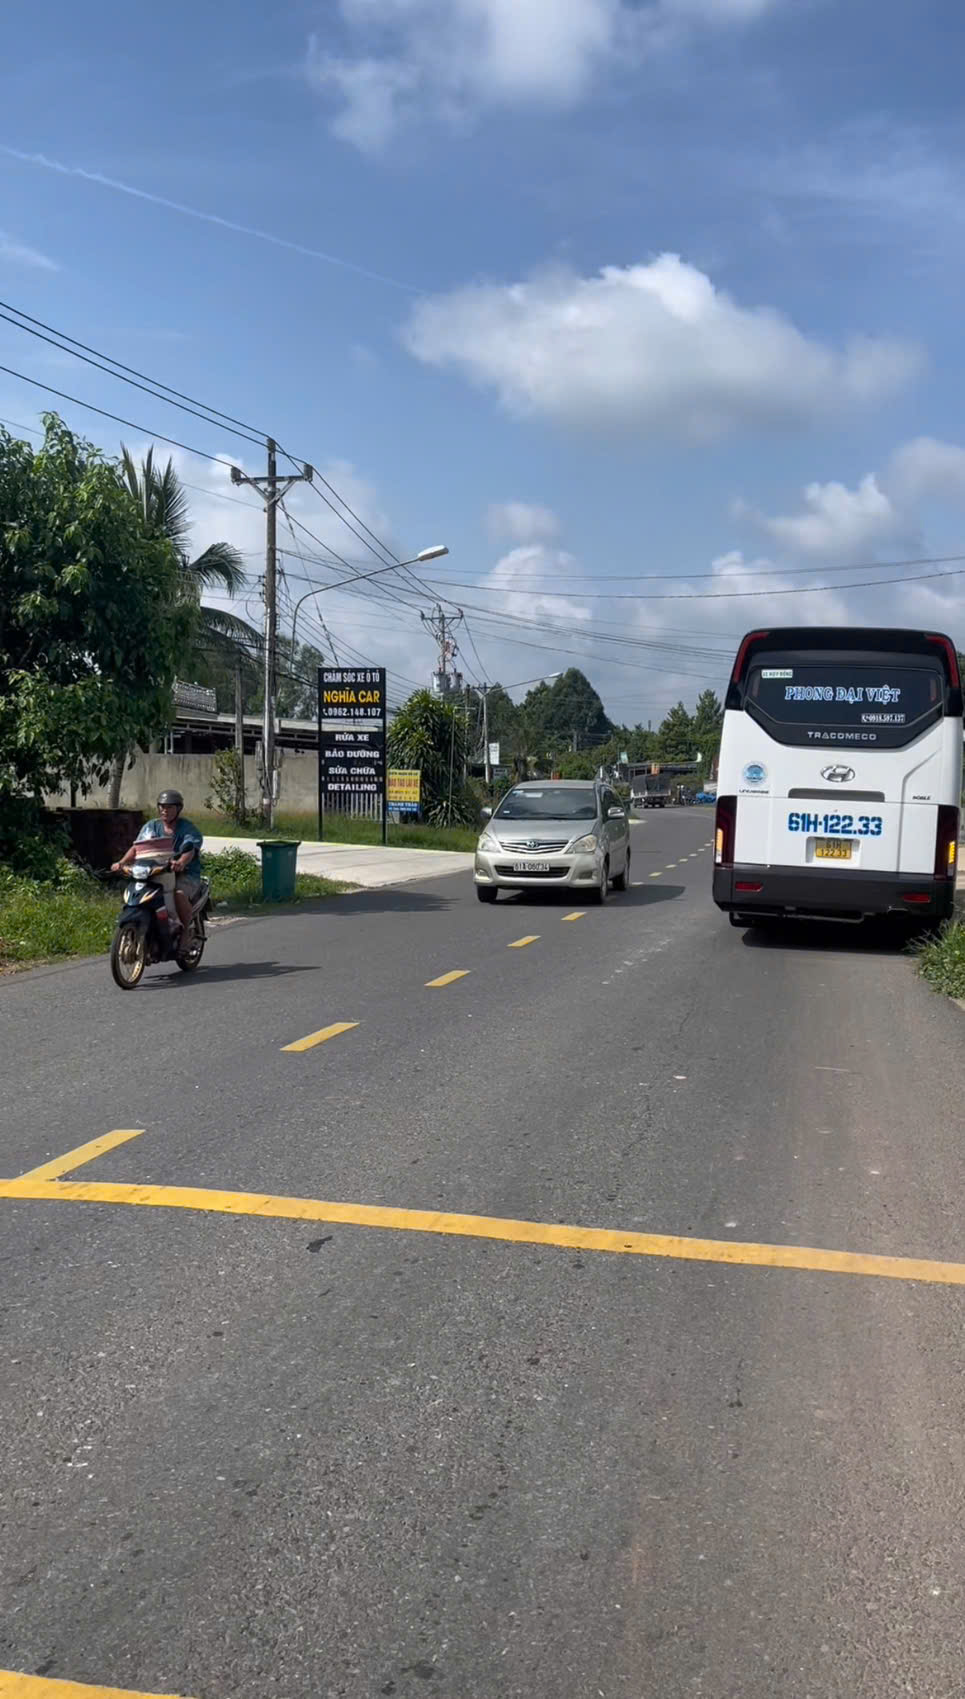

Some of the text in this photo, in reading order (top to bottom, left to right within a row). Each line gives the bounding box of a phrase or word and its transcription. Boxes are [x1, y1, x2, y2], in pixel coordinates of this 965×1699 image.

[356, 671, 366, 683] XE
[323, 687, 380, 703] NGHĨA CAR
[785, 684, 901, 705] PHONG ĐẠI VIỆT
[807, 731, 877, 740] TRACOMECO
[328, 783, 377, 791] DETAILING
